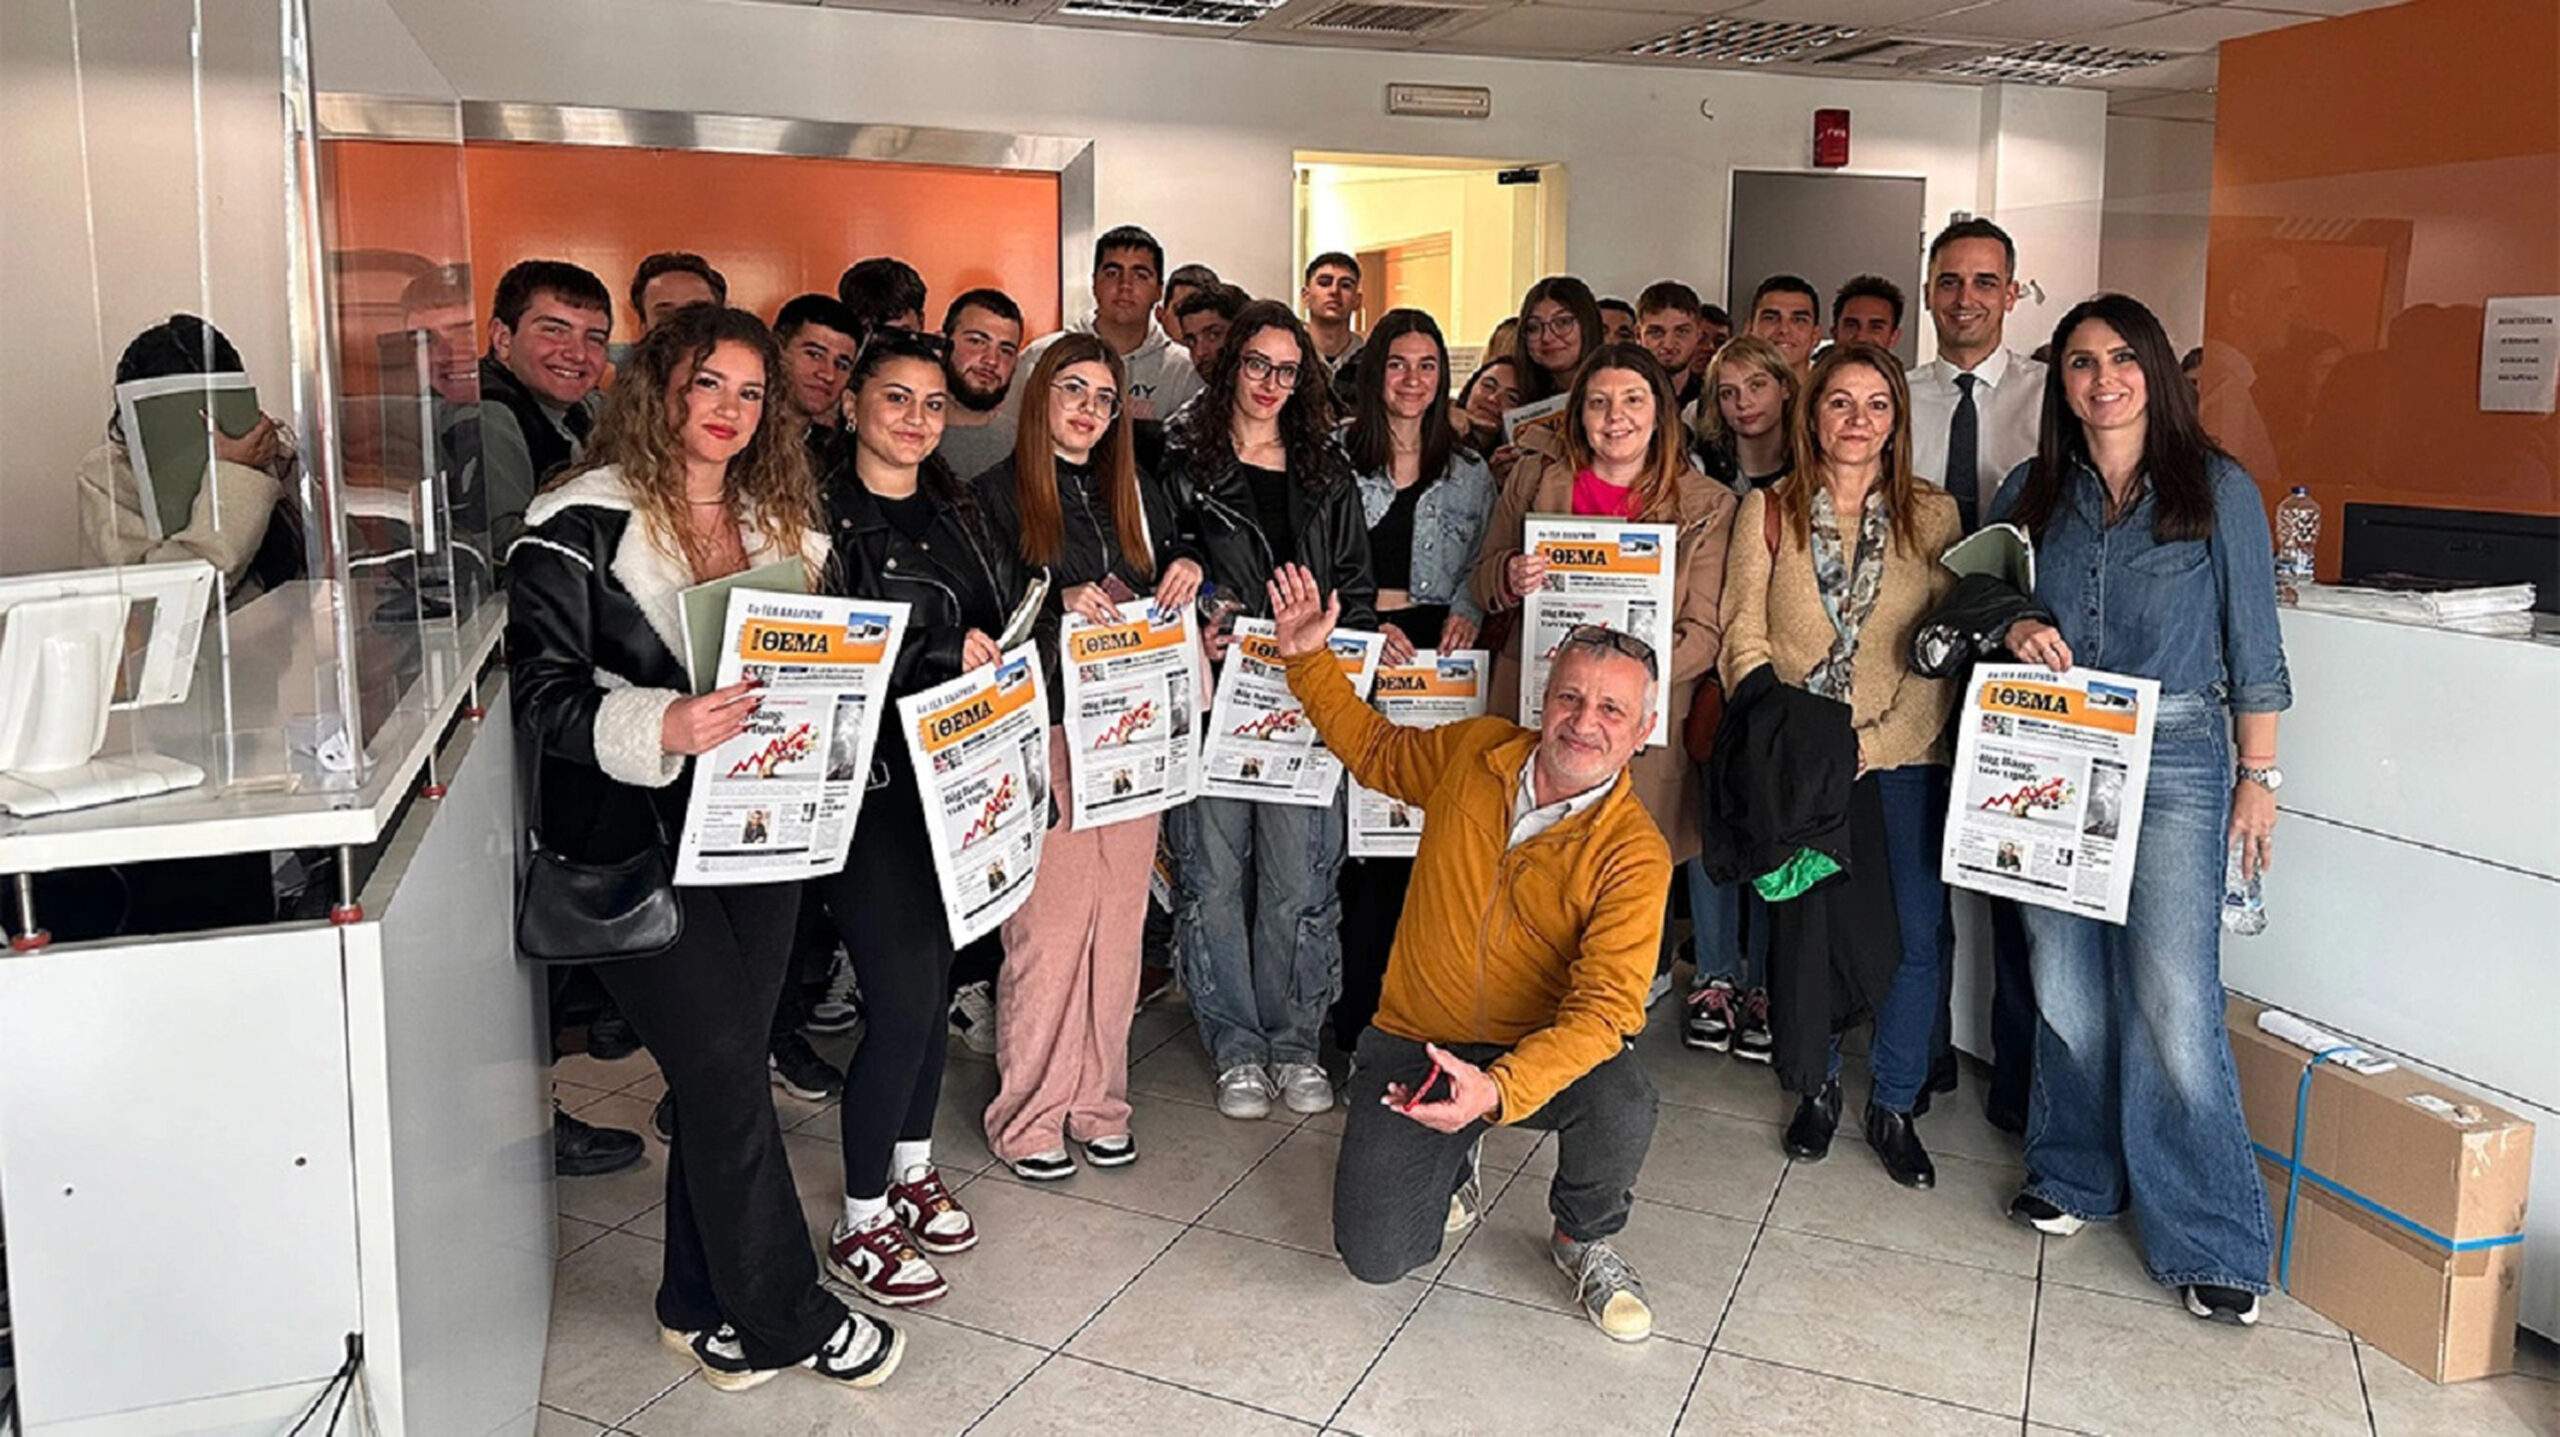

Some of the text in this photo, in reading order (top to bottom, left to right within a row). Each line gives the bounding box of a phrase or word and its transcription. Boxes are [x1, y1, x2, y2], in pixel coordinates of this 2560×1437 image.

[1552, 549, 1608, 566] ΘΕΜΑ
[762, 630, 829, 653] ΘΕΜΑ
[1086, 631, 1143, 652] ΘΕΜΑ
[1999, 688, 2070, 714] ΘΕΜΑ
[938, 699, 994, 738] ΘΕΜΑ
